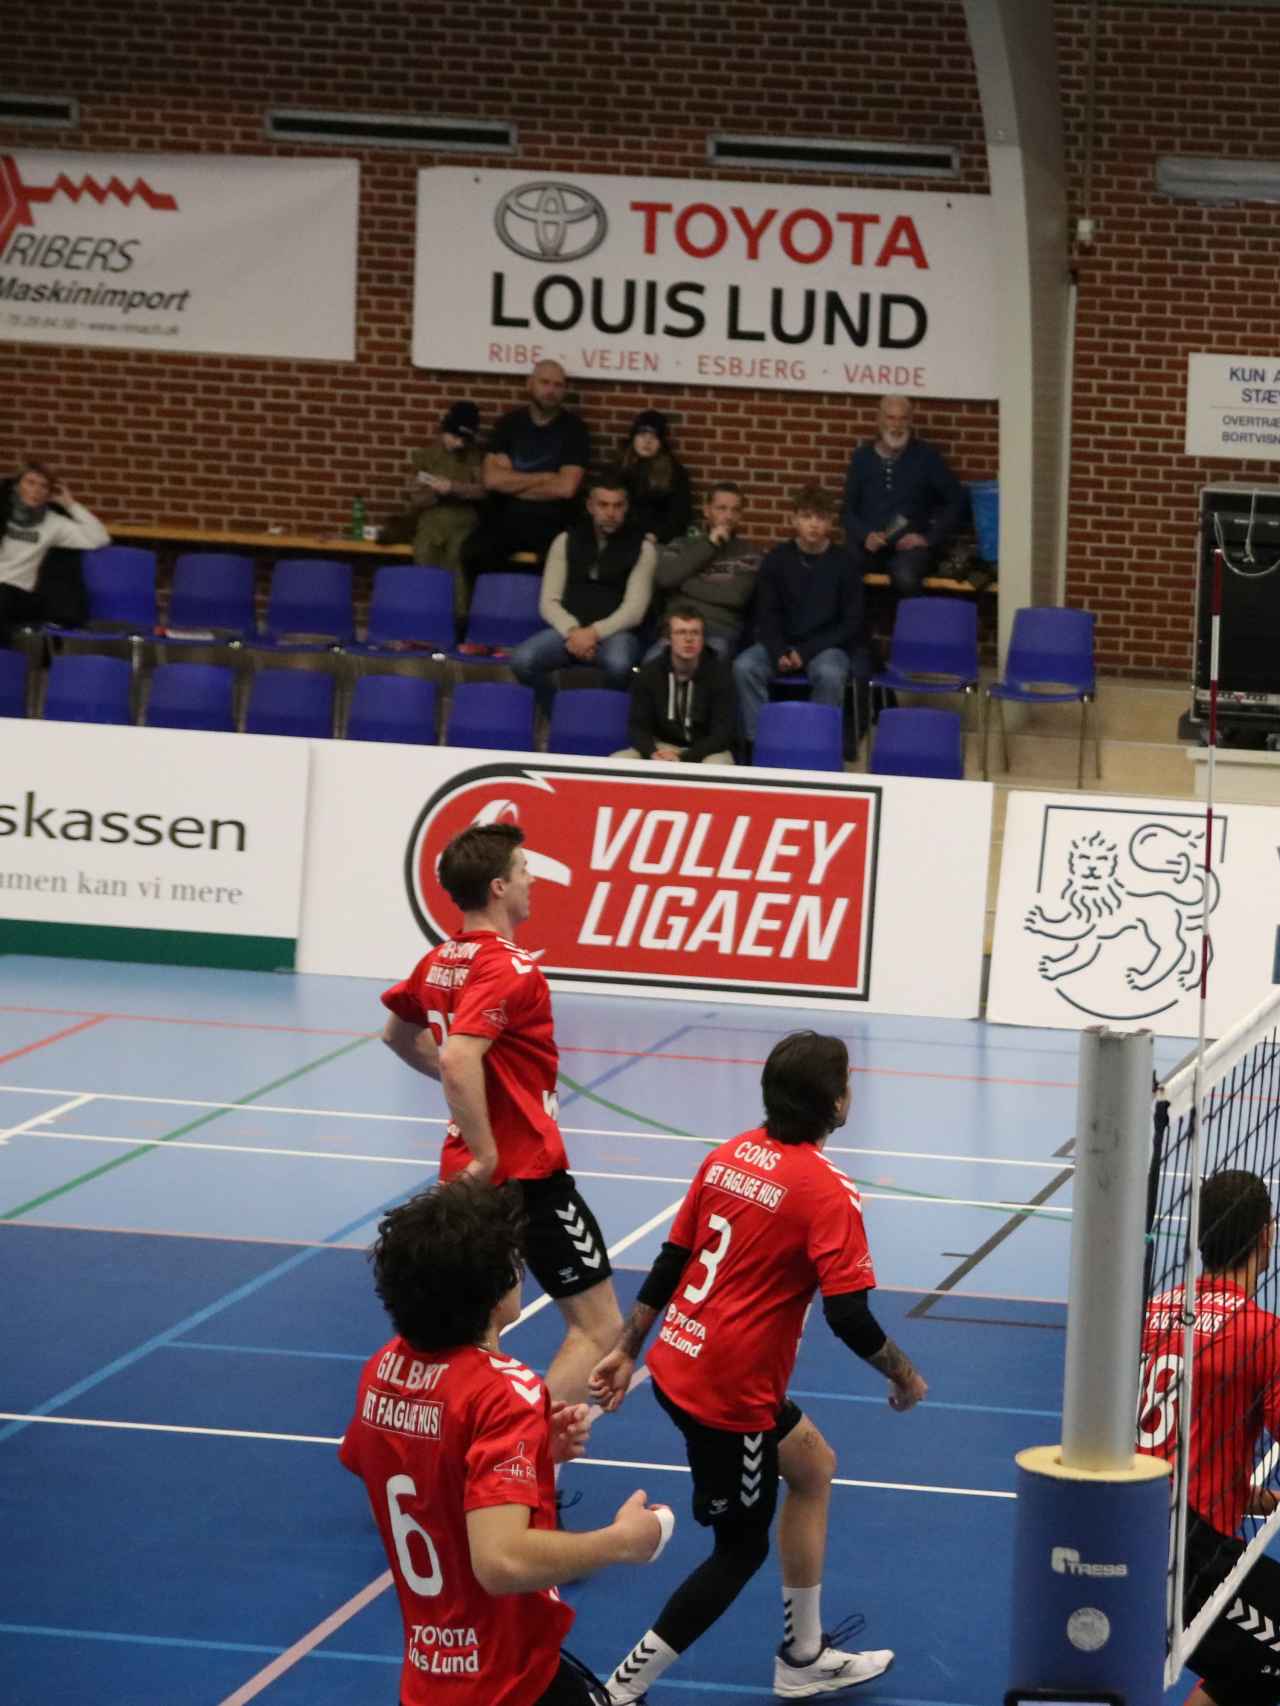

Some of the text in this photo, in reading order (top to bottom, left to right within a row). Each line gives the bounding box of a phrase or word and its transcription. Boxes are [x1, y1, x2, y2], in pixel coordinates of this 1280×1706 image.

[4, 231, 141, 274] RIBERS
[630, 201, 930, 269] TOYOTA
[490, 272, 929, 349] LOUIS LUND
[488, 342, 926, 387] RIBE VEJEN ESBJERG VARDE
[1229, 367, 1265, 384] KUN
[589, 805, 856, 886] VOLLEY
[0, 869, 244, 905] men kan vi mere
[577, 881, 849, 962] LIGAEN
[733, 1140, 782, 1172] CONS
[719, 1170, 762, 1200] FAGLIGE
[757, 1182, 783, 1208] HUS
[683, 1213, 732, 1304] 3
[385, 1473, 443, 1597] 6
[430, 1650, 480, 1674] Lund
